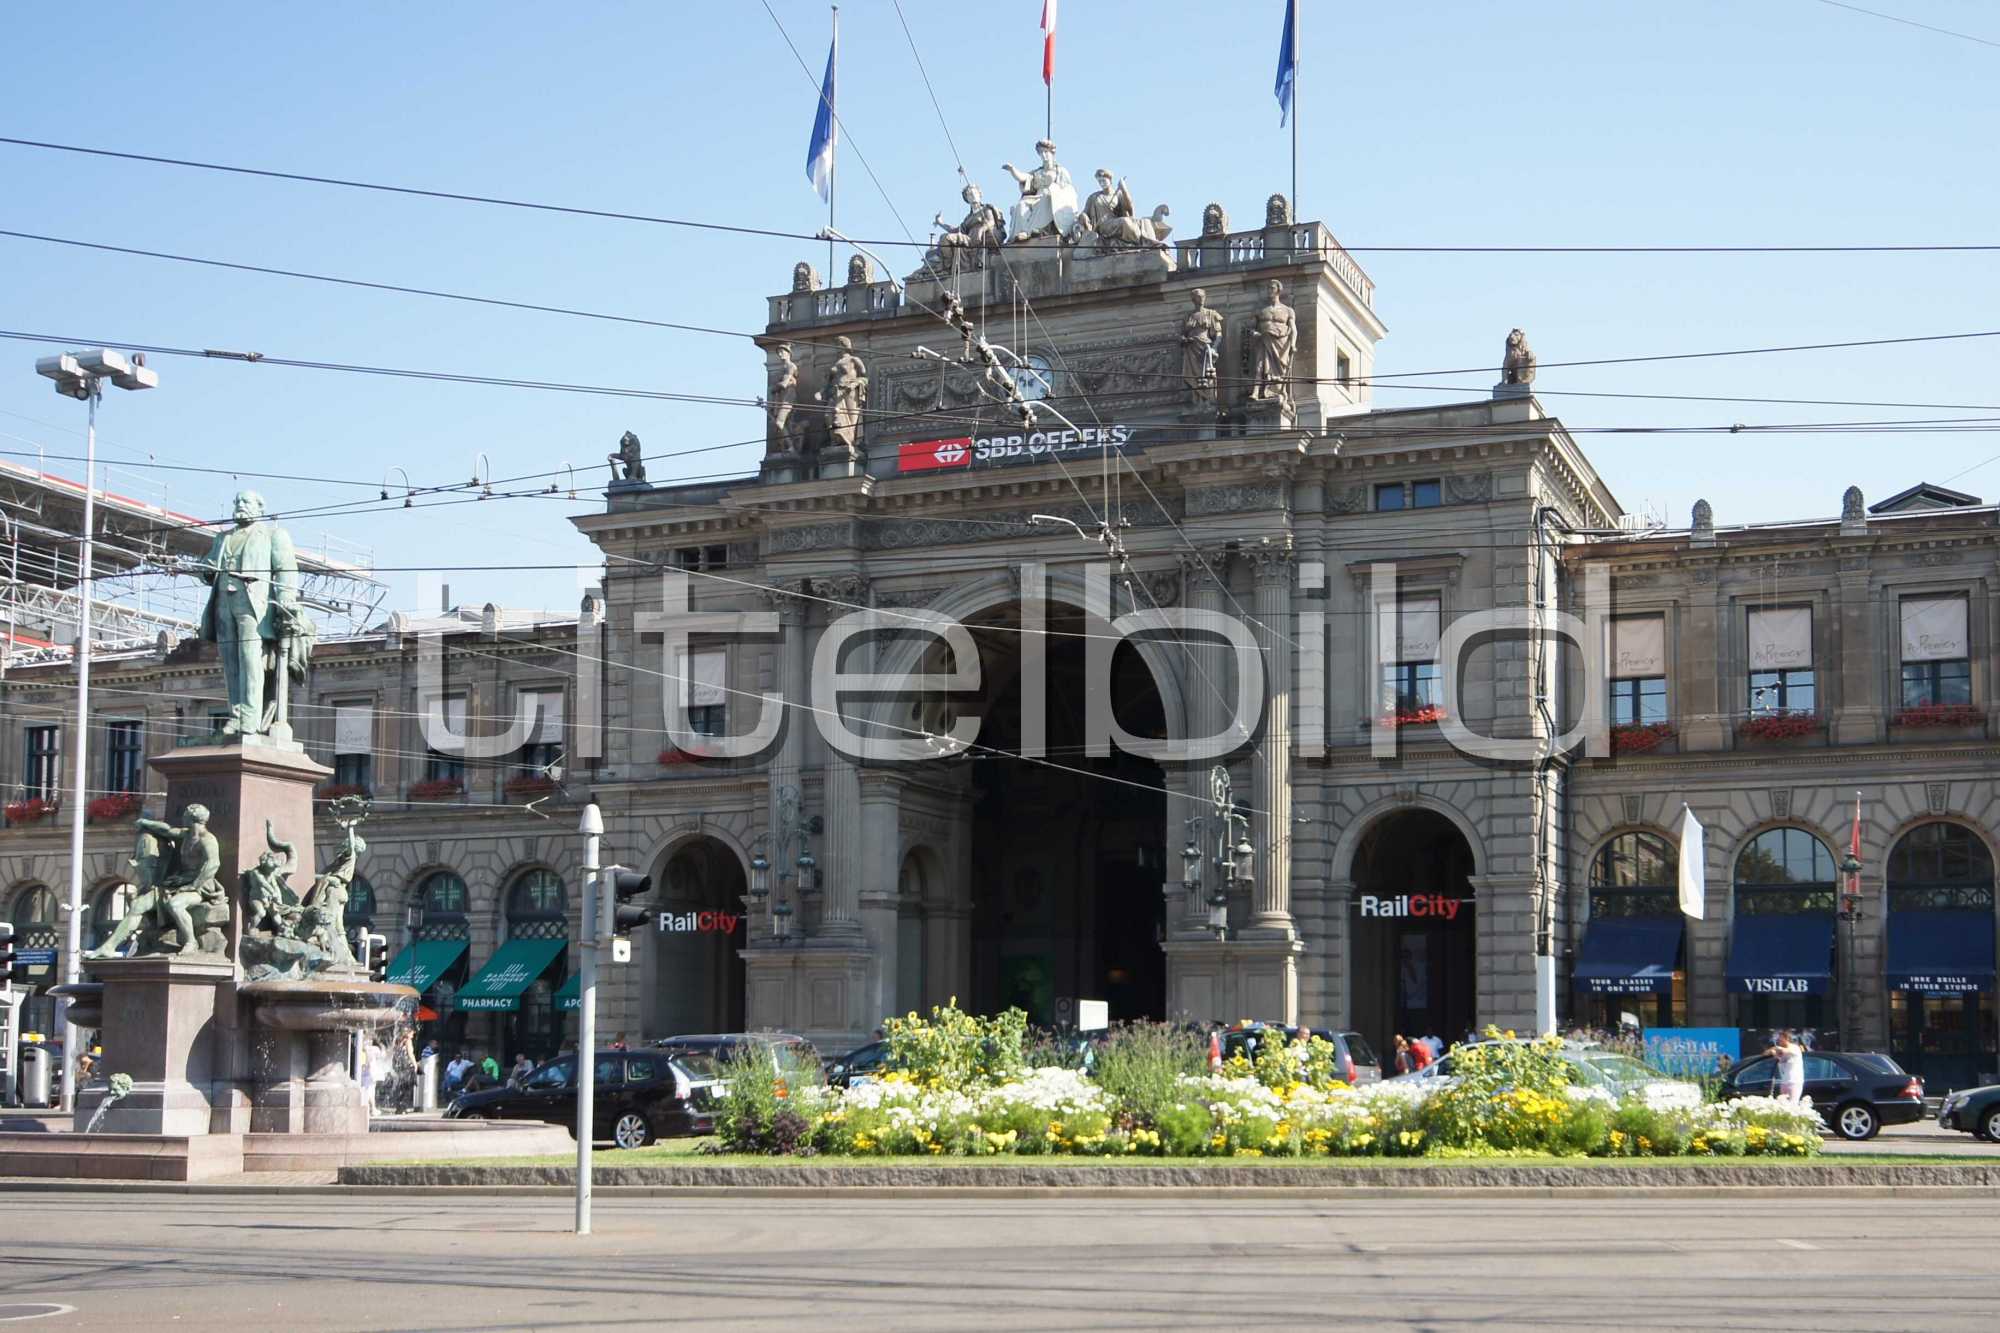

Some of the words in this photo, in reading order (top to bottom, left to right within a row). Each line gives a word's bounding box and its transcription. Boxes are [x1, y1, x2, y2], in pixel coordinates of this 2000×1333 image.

[975, 435, 1022, 460] SBB
[1361, 895, 1460, 920] RailCity
[660, 912, 737, 934] RailCity
[1744, 978, 1808, 992] VISILAB
[462, 998, 513, 1008] PHARMACY
